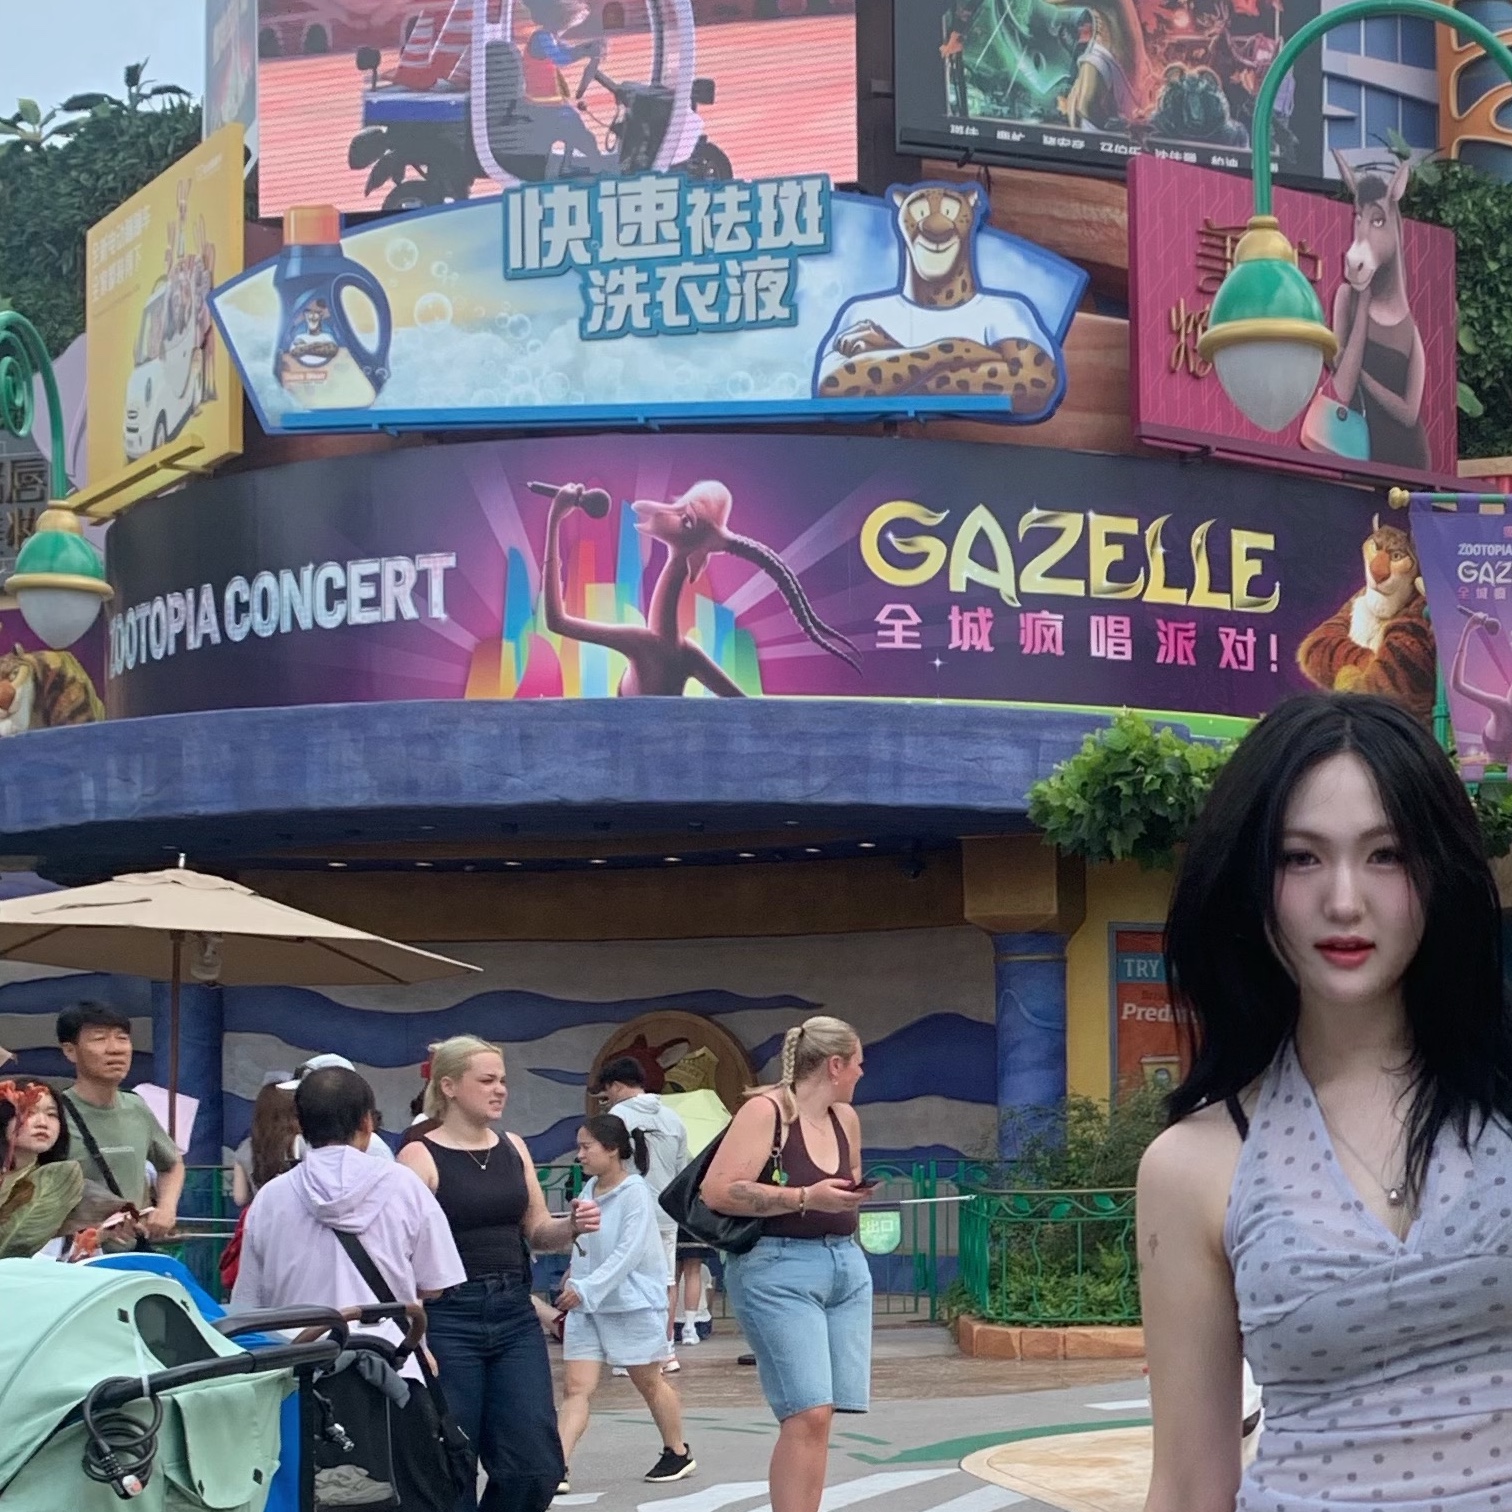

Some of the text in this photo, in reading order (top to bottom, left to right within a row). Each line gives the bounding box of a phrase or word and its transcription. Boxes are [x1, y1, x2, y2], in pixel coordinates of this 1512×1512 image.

[508, 175, 825, 270] 快速祛斑
[587, 255, 790, 335] 洗衣液
[860, 500, 1280, 613] GAZELLE
[1457, 543, 1512, 556] ZOOTOPIA
[224, 552, 457, 643] CONCERT
[1123, 958, 1161, 979] TRY
